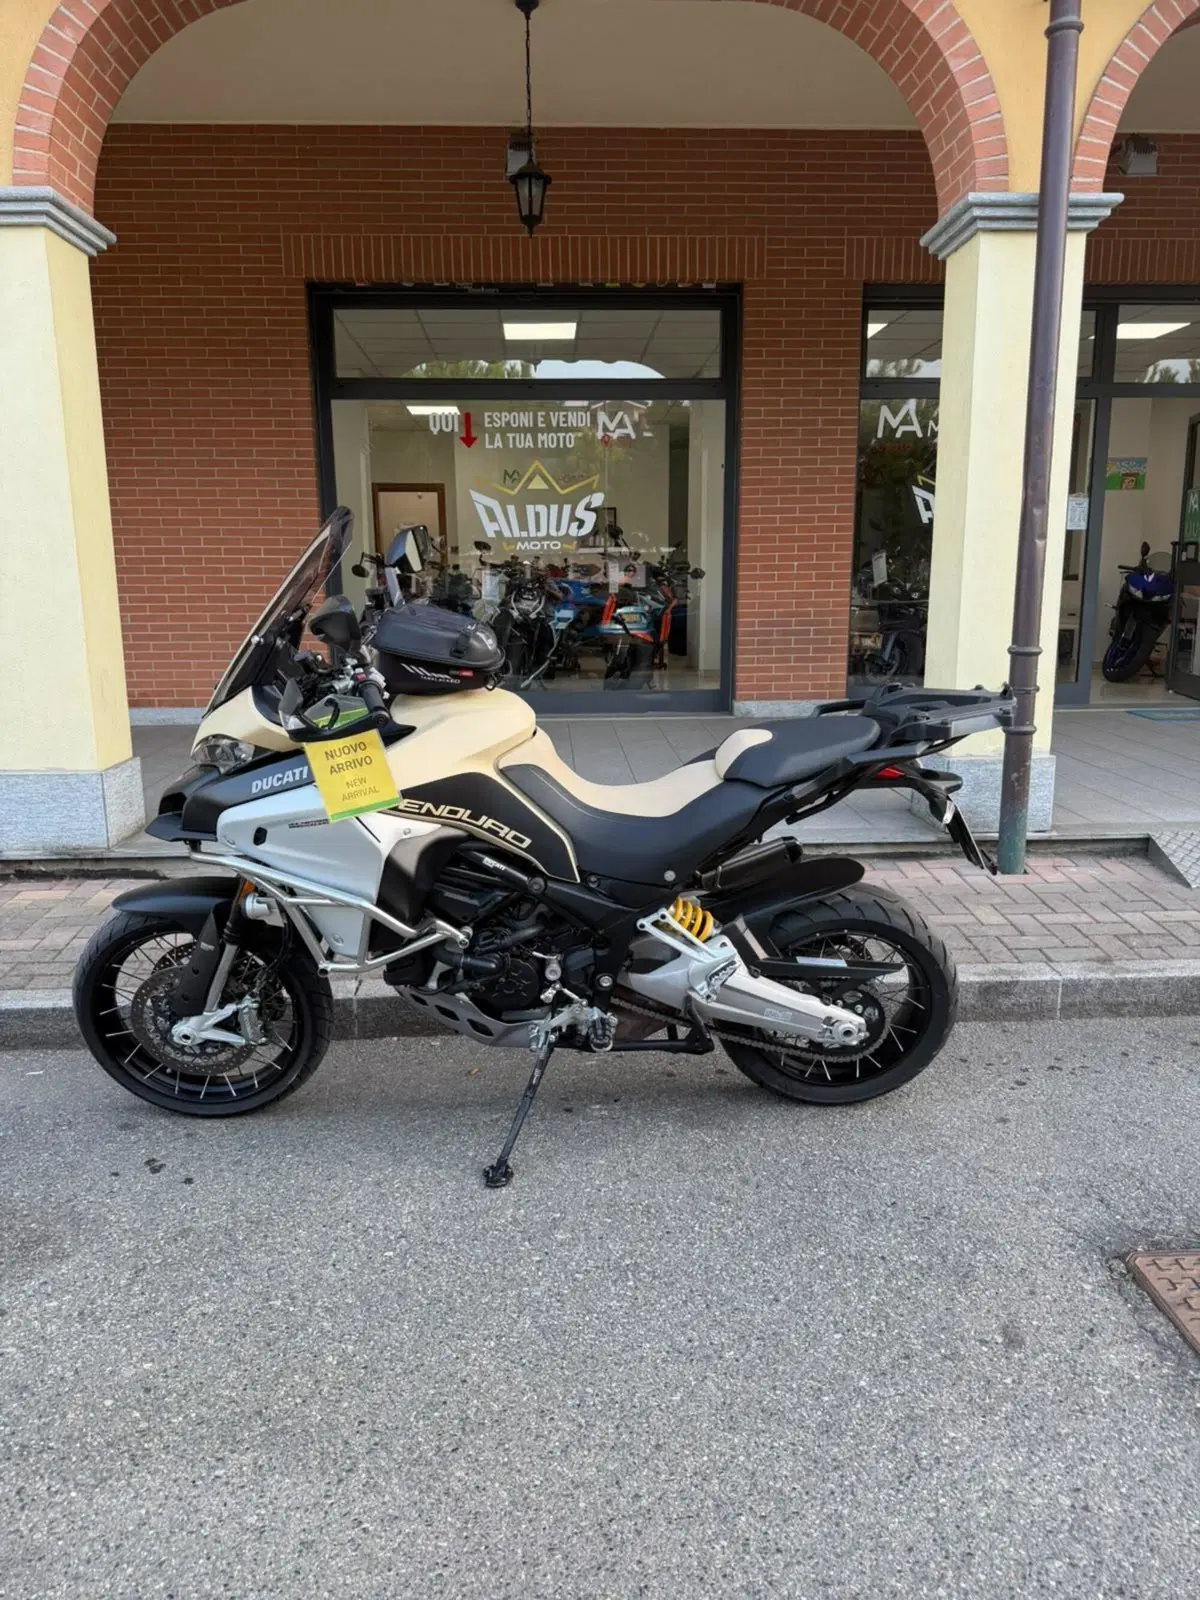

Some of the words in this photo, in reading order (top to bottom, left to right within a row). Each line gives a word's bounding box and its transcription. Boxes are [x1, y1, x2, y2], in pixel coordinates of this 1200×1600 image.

[429, 412, 459, 435] QUI
[484, 412, 533, 427] ESPONI
[538, 412, 546, 427] E
[550, 412, 591, 427] VENDI
[485, 433, 502, 448] LA
[507, 433, 533, 448] TUA
[537, 432, 575, 448] MOTO
[468, 488, 605, 538] ALDUS
[516, 541, 561, 550] MOTO
[324, 741, 367, 761] NUOVO
[329, 755, 373, 775] ARRIVO
[251, 766, 308, 794] DUCATI
[346, 776, 367, 789] NEW
[342, 786, 380, 802] ARRIVAL
[398, 798, 532, 849] ENDURO
